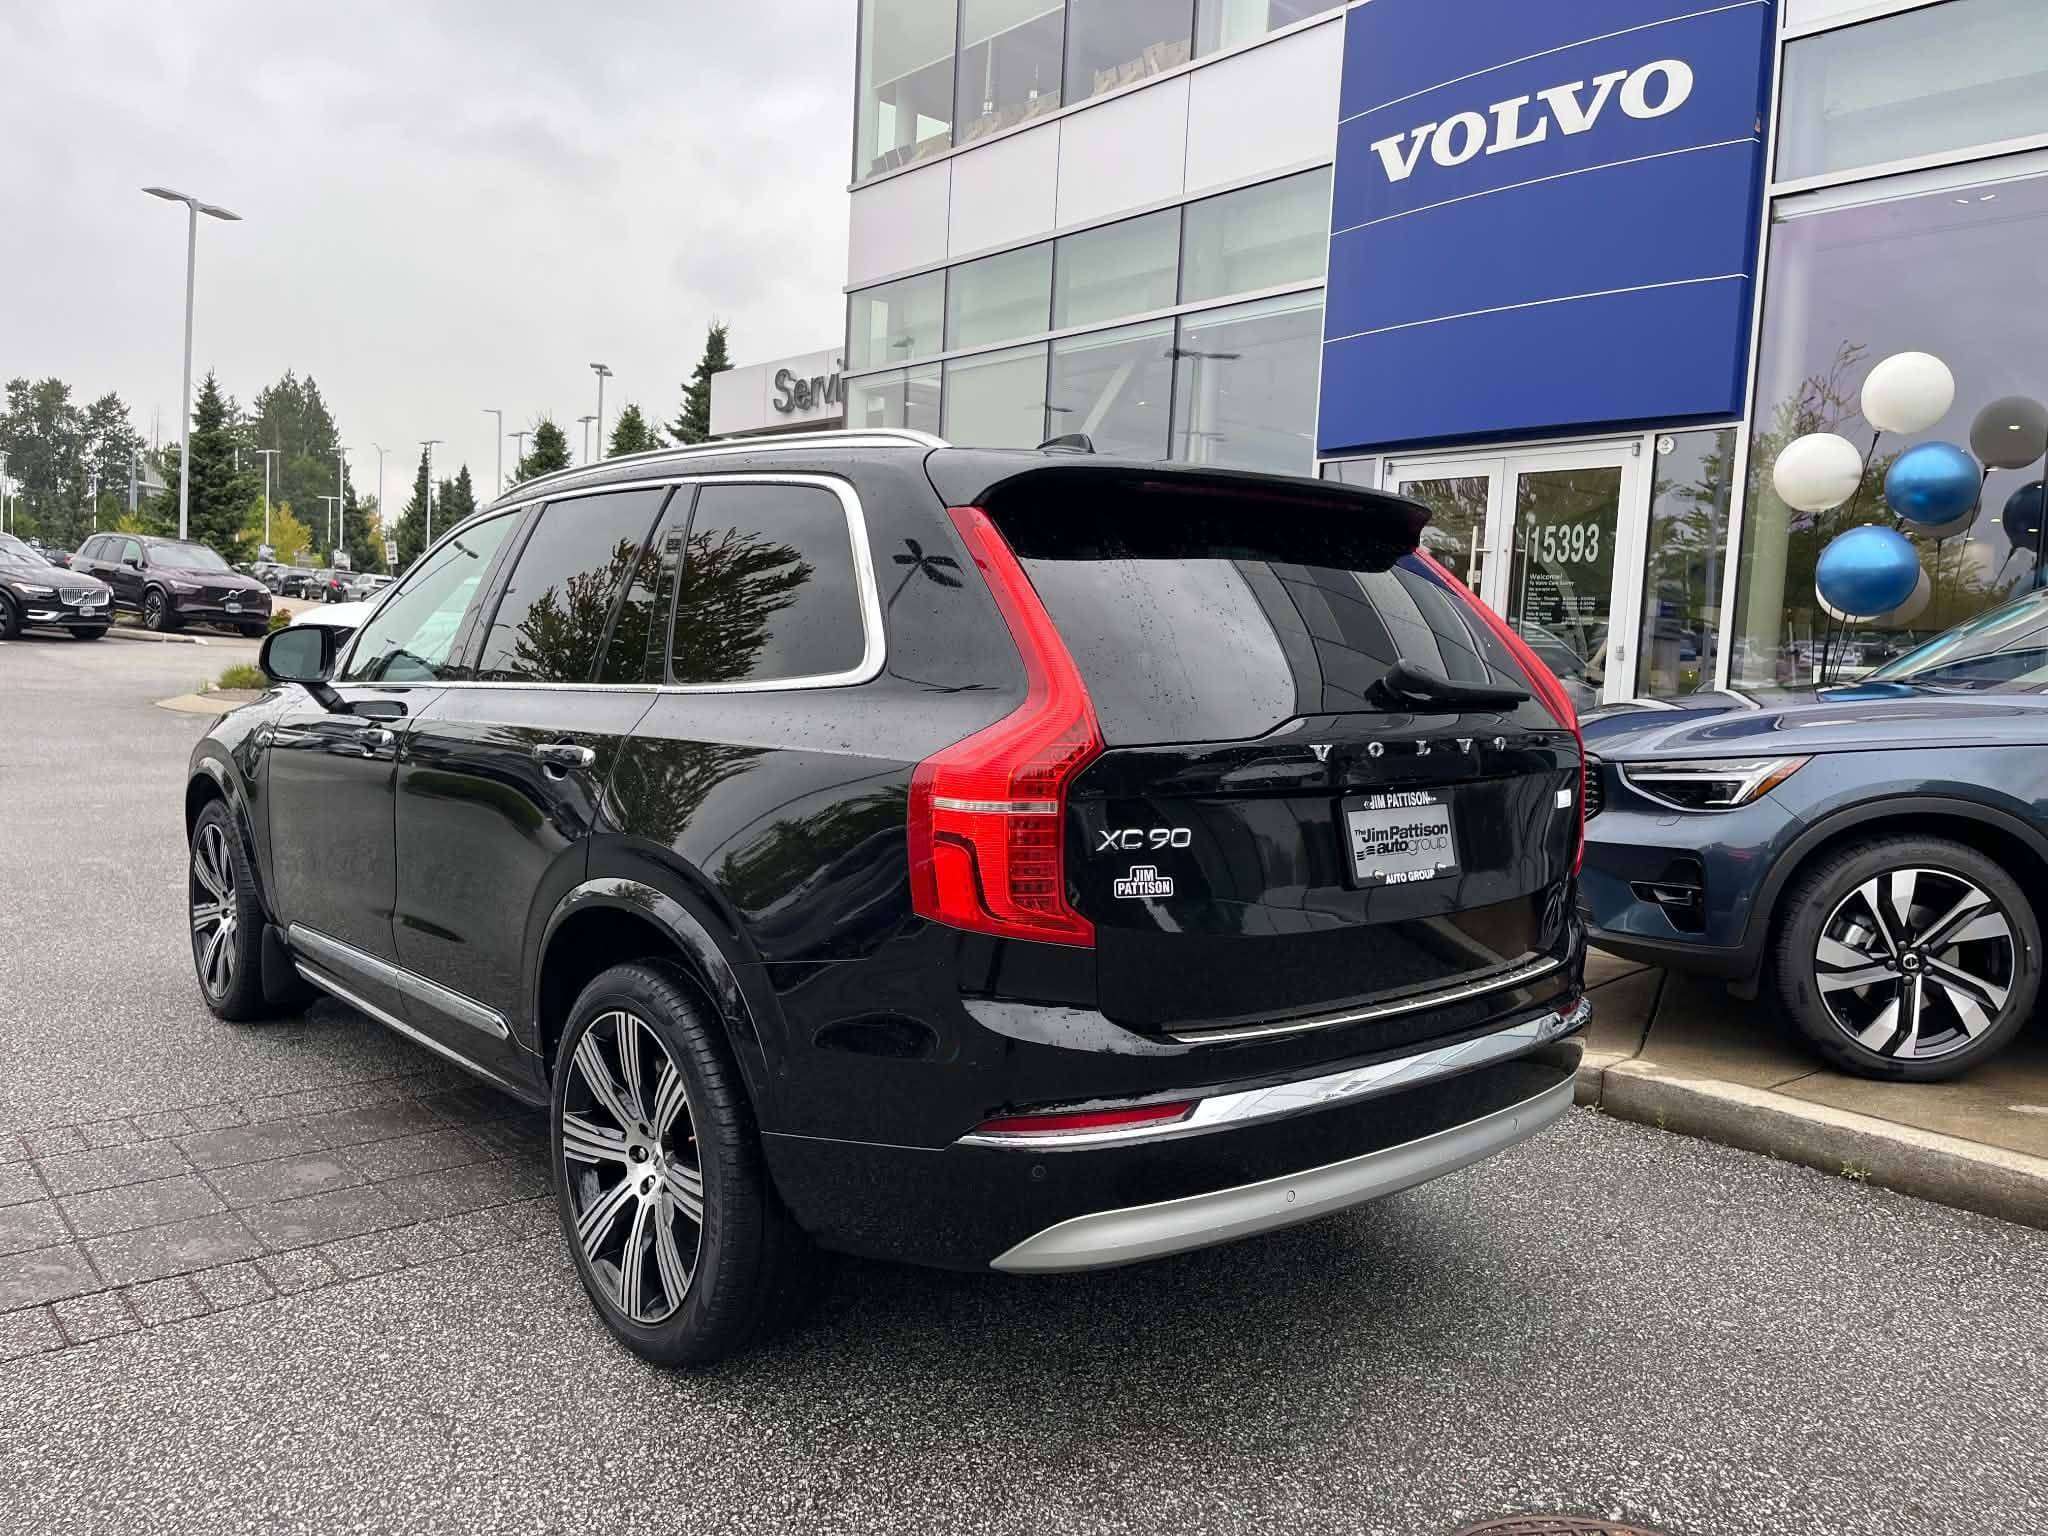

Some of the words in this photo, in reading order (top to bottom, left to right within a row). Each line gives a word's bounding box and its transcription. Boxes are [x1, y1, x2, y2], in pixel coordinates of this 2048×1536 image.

[1370, 59, 1694, 183] VOLVO
[1531, 523, 1600, 563] 15393
[1309, 736, 1507, 762] VOLVO
[1370, 794, 1386, 809] JIM
[1386, 791, 1429, 808] PATTISON
[1133, 869, 1154, 882] JIM
[1385, 872, 1407, 885] AUTO
[1407, 868, 1435, 881] GROUP
[1117, 880, 1170, 895] PATTISON
